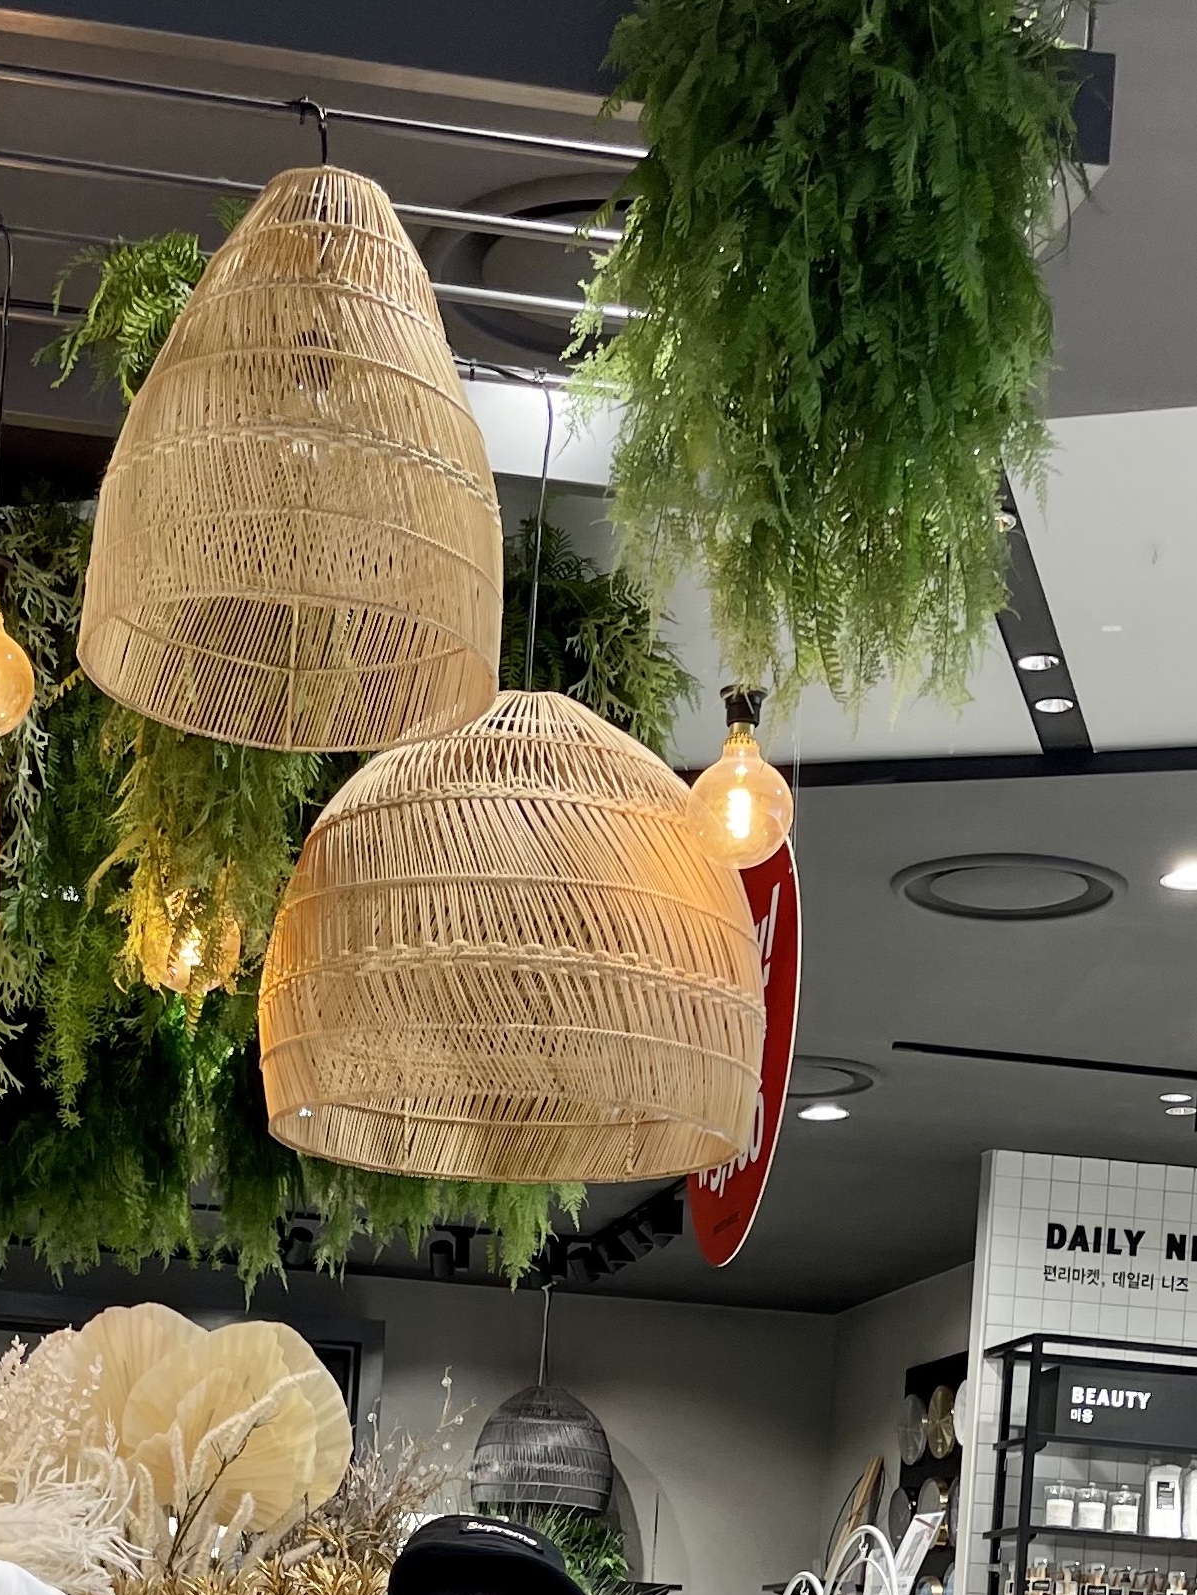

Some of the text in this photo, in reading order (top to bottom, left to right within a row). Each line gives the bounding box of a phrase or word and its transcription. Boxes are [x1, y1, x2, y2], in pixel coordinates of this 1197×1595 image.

[1046, 1222, 1146, 1257] DAILY
[1043, 1265, 1189, 1292] 편리마켓, 데일리 니즈
[1071, 1386, 1152, 1410] BEAUTY
[1070, 1408, 1094, 1424] 미용
[466, 1521, 538, 1546] Supreme
